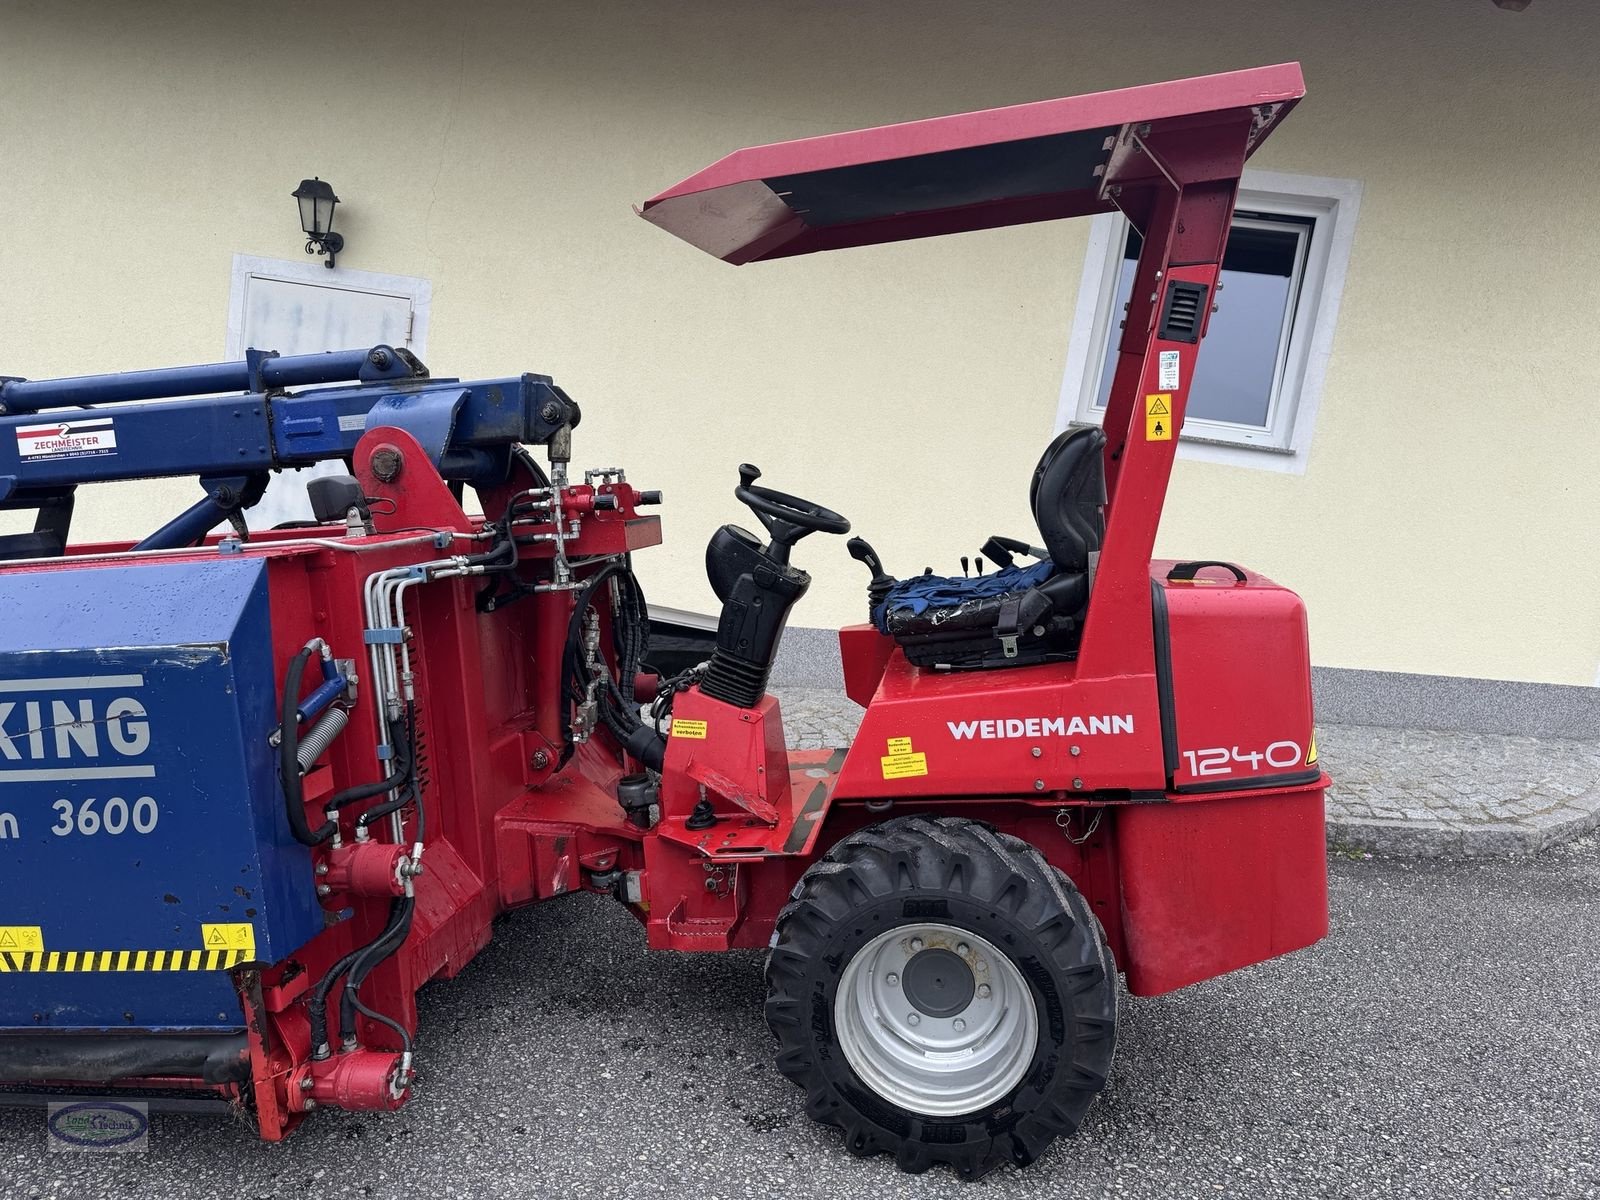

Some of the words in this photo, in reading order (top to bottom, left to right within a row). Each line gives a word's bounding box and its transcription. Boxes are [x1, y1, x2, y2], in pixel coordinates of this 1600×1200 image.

[34, 436, 99, 449] ZECHMEISTER
[946, 714, 1134, 740] WEIDEMANN
[1183, 740, 1302, 777] 1240
[51, 796, 158, 836] 3600
